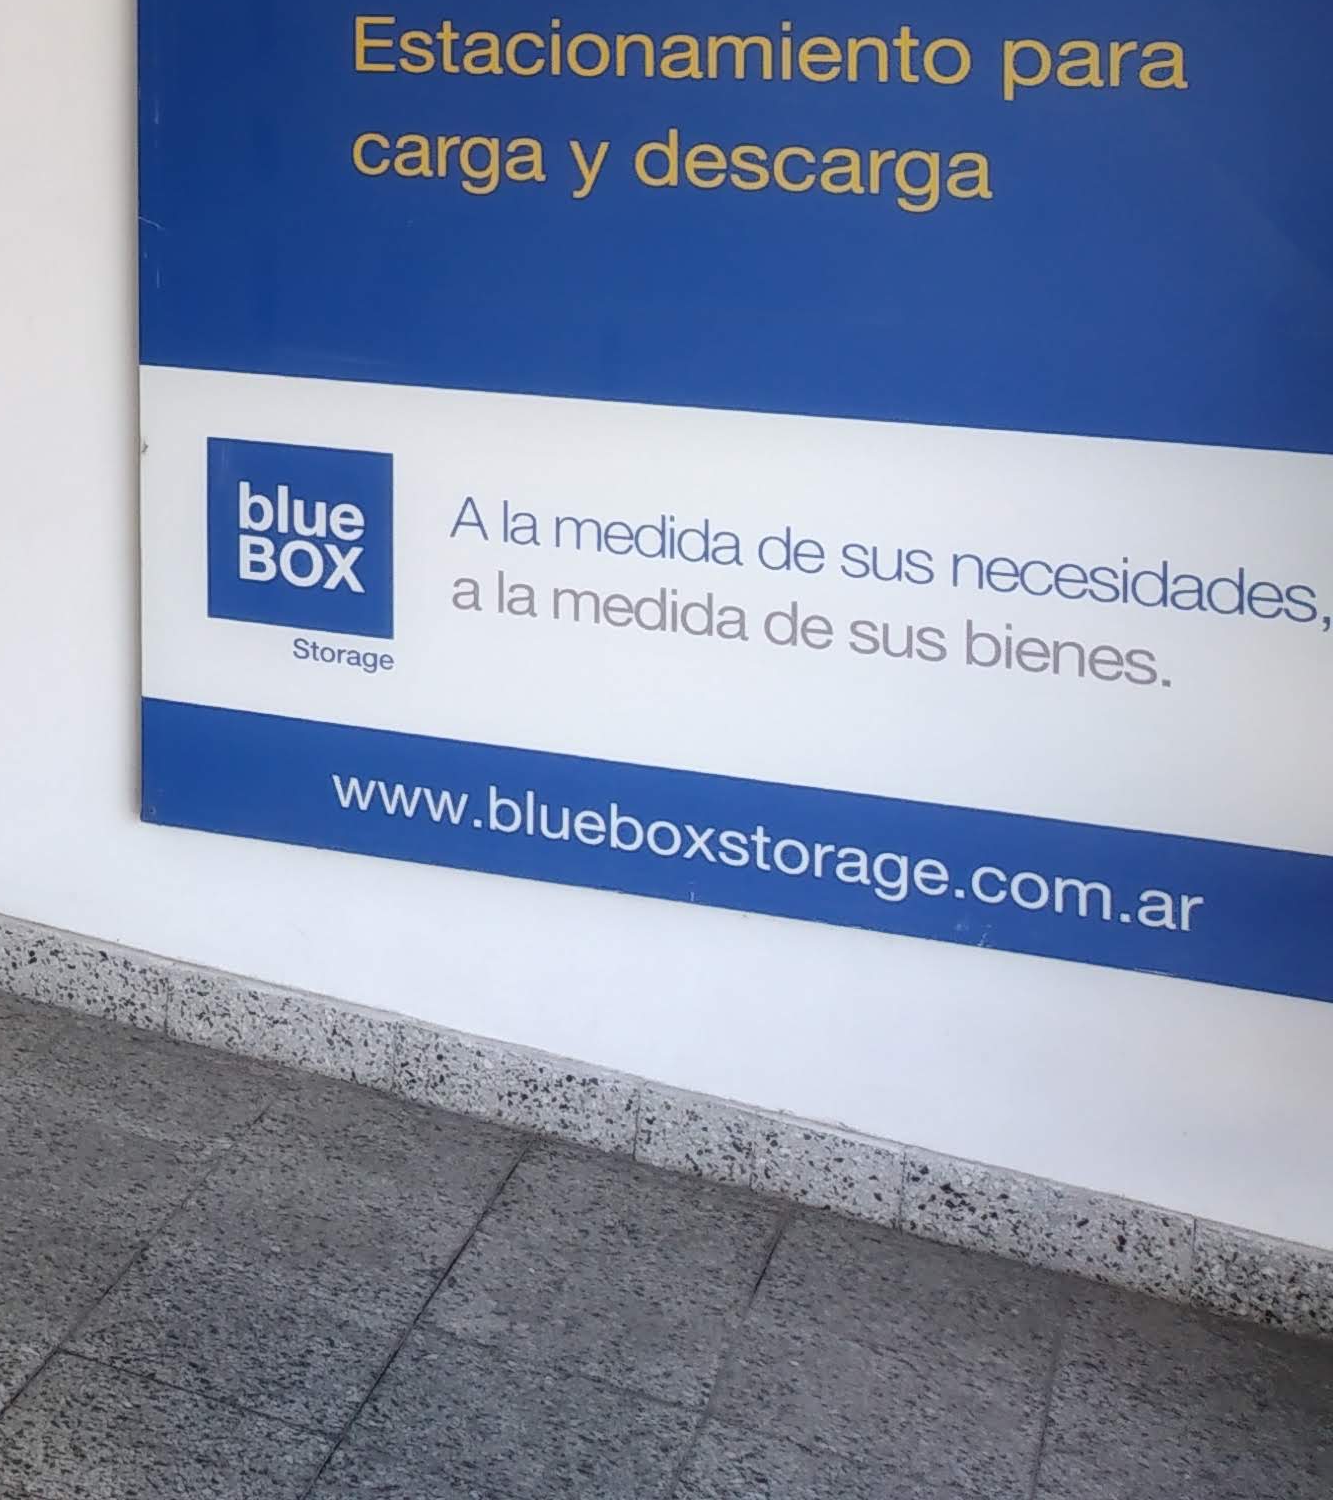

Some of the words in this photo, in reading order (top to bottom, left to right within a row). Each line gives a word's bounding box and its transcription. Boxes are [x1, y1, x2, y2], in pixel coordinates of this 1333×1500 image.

[353, 16, 971, 85] Estacionamiento
[1002, 38, 1189, 101] para
[350, 130, 547, 196] carga
[570, 139, 610, 199] y
[634, 128, 993, 214] descarga
[236, 481, 367, 542] blue
[236, 543, 367, 596] BOX
[449, 496, 490, 540] A
[501, 497, 540, 548] la
[554, 506, 743, 570] medida
[757, 522, 826, 576] de
[840, 540, 935, 587] sus
[951, 547, 1333, 632] necesidades,
[292, 637, 395, 673] Storage
[450, 573, 483, 612] a
[497, 569, 537, 619] la
[552, 579, 748, 643] medida
[763, 595, 835, 651] de
[848, 618, 948, 665] sus
[964, 621, 1174, 690] bienes.
[332, 771, 1205, 935] www.blueboxstorage.com.ar
